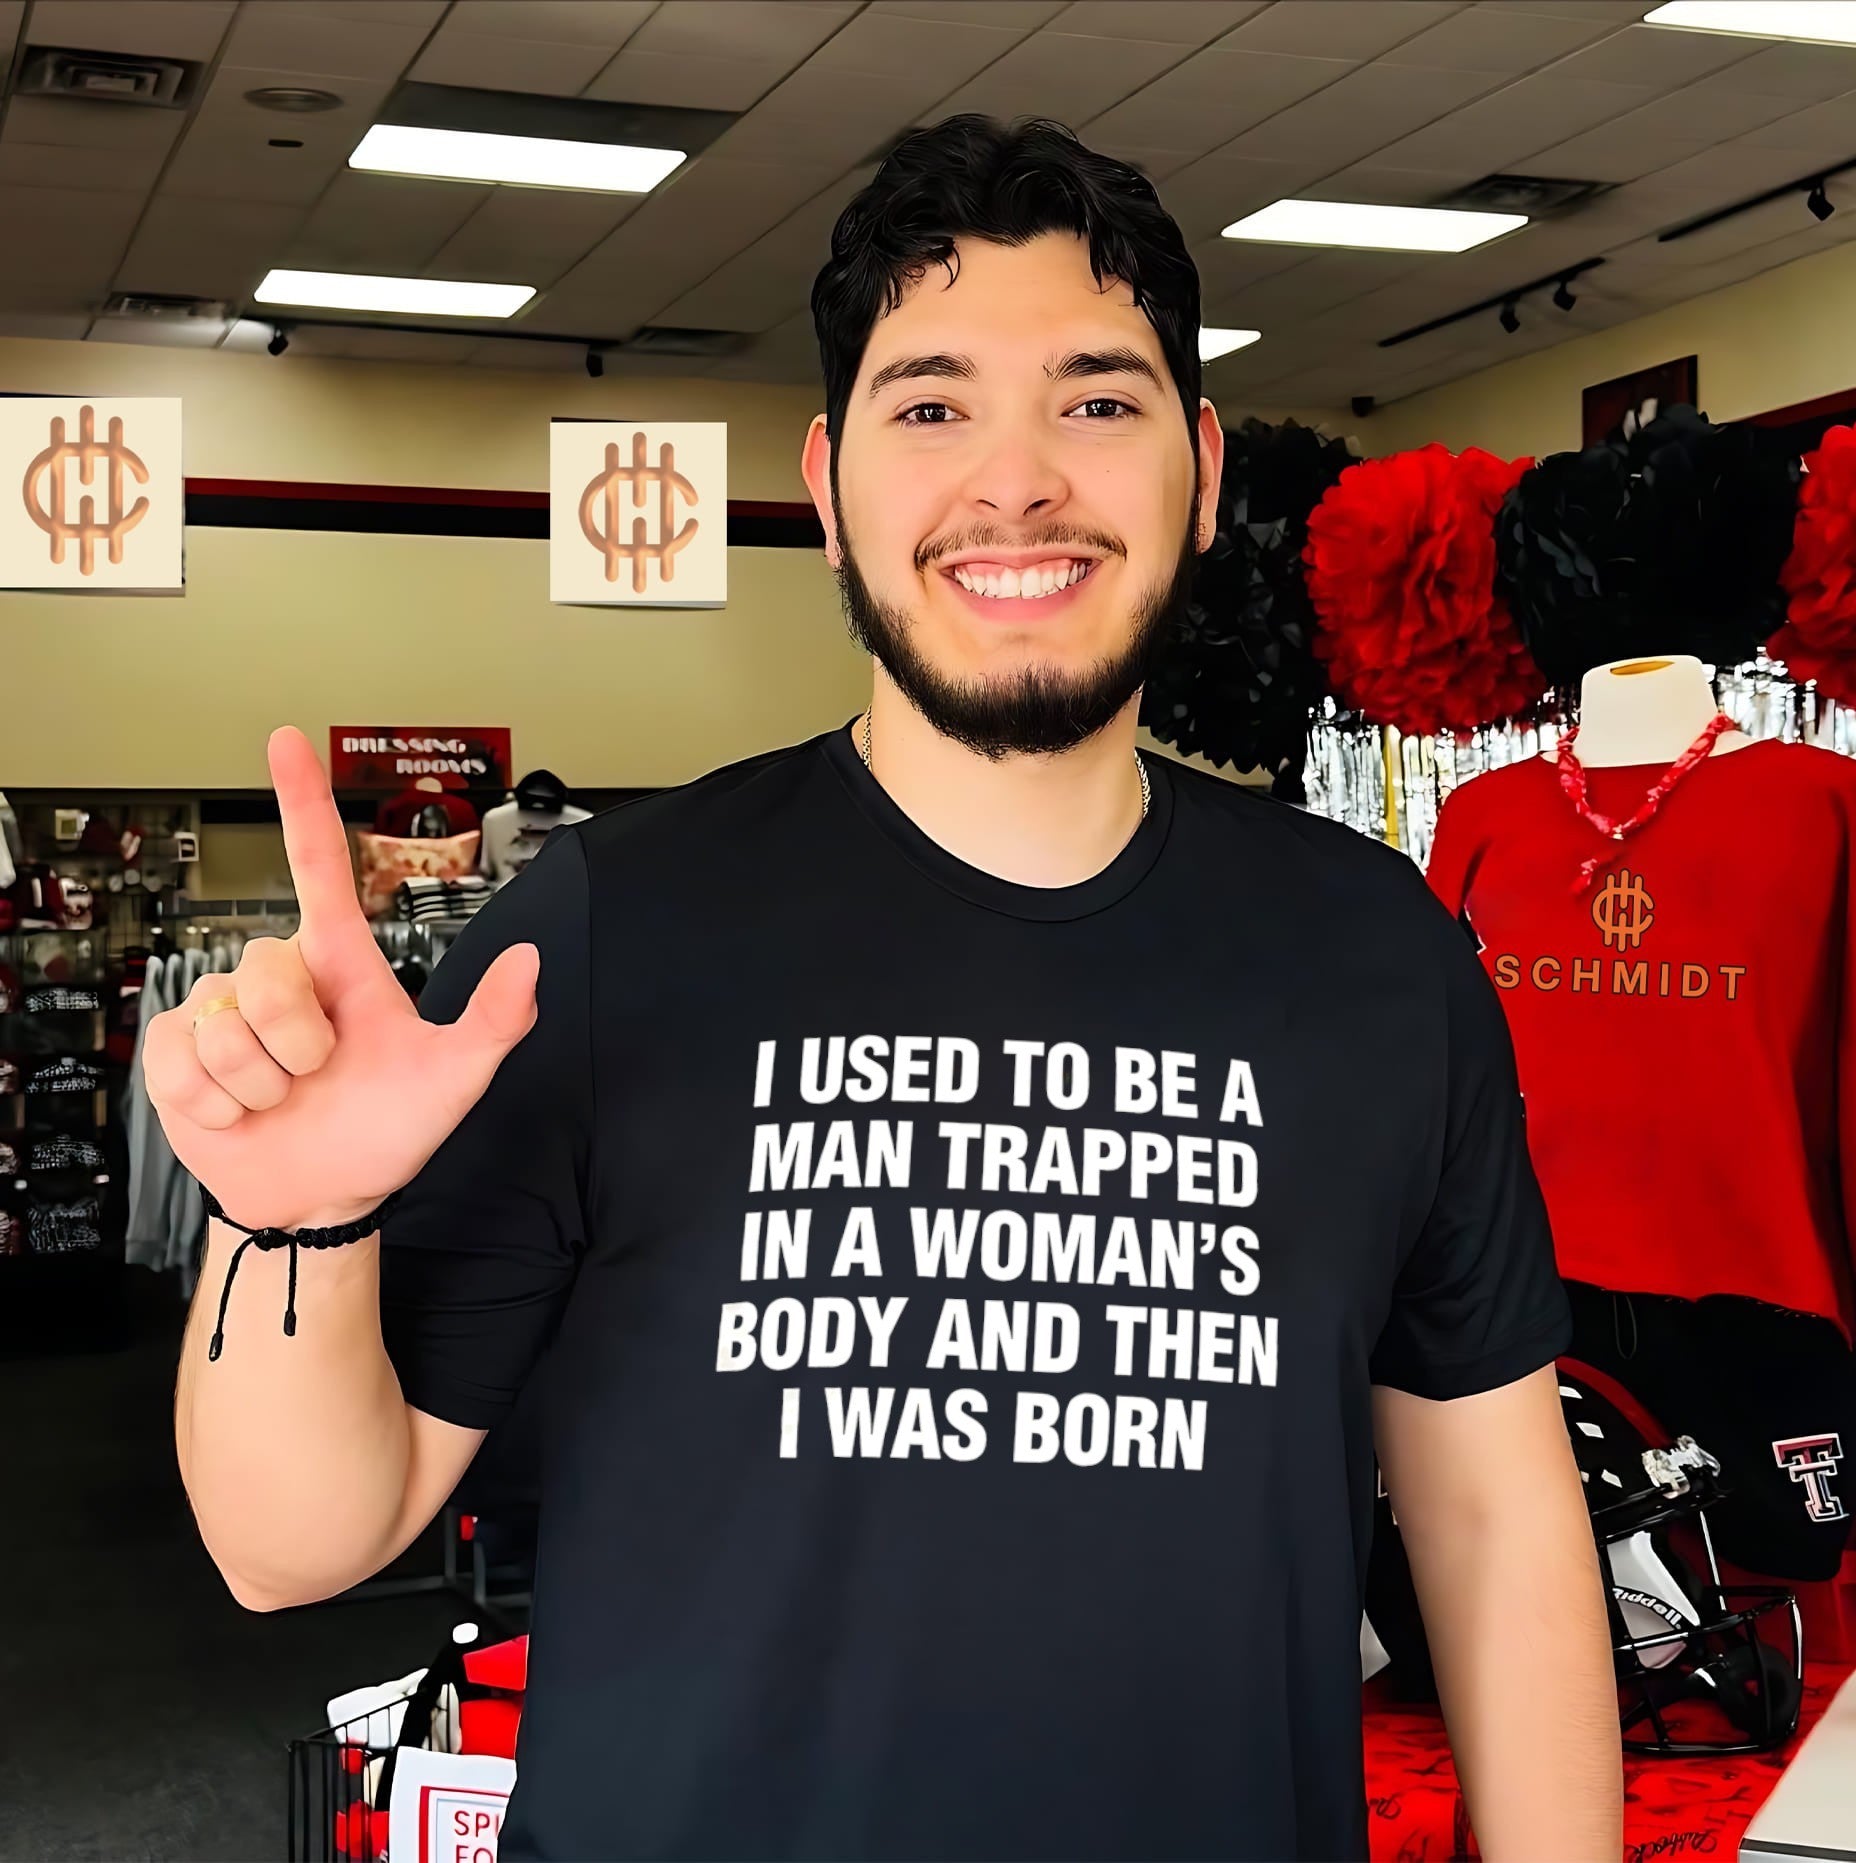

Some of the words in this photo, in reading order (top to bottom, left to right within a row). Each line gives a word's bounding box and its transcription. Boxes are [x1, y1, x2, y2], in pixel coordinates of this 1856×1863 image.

[341, 737, 467, 754] DRESSING
[395, 758, 487, 775] ROOMS
[1494, 953, 1747, 1000] SCHMIDT
[754, 1040, 776, 1107] I
[800, 1035, 979, 1104] USED
[1003, 1040, 1089, 1110] TO
[1115, 1047, 1198, 1118] BE
[1219, 1059, 1263, 1127] A
[749, 1120, 913, 1192] MAN
[939, 1122, 1258, 1207] TRAPPED
[741, 1209, 812, 1281] IN
[831, 1207, 882, 1277] A
[716, 1297, 909, 1372] BODY
[926, 1298, 1080, 1373] AND
[1106, 1305, 1278, 1387] THEN
[780, 1388, 800, 1458] I
[825, 1387, 988, 1461] WAS
[1013, 1392, 1207, 1470] BORN
